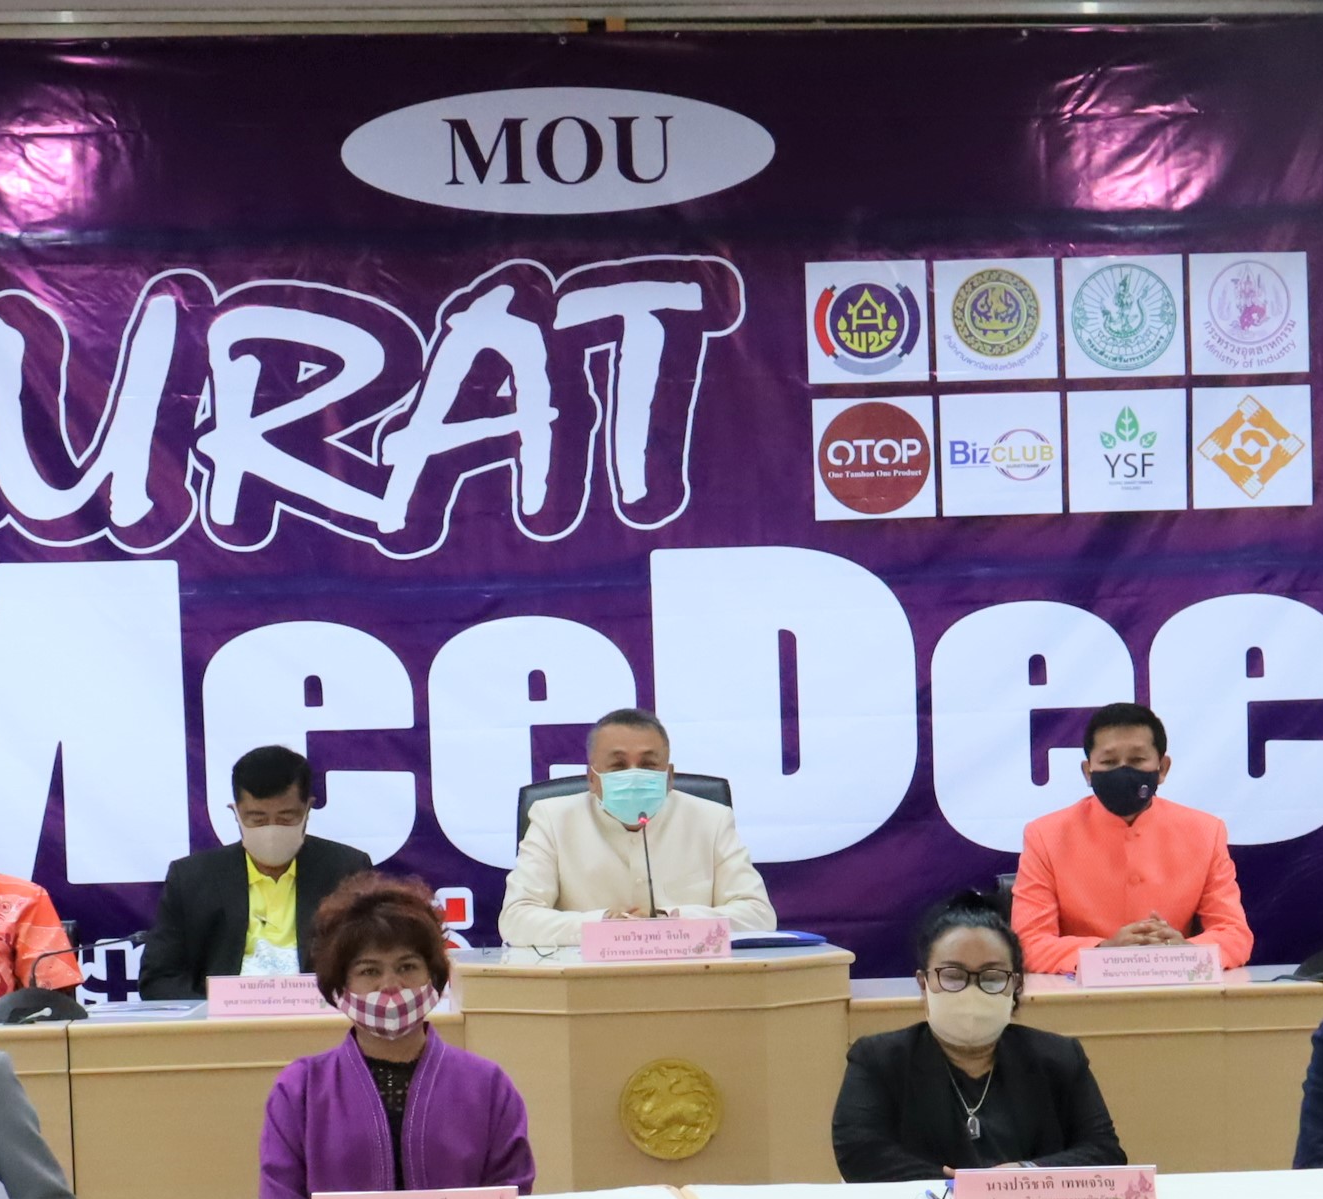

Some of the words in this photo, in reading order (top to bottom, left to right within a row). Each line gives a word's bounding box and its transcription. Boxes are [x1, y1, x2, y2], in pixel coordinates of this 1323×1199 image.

[441, 115, 675, 187] MOU
[1203, 339, 1239, 368] Ministry
[1242, 358, 1254, 368] of
[1256, 339, 1297, 368] Industry
[827, 438, 922, 466] OTOP
[828, 470, 843, 479] One
[876, 469, 892, 477] One
[893, 468, 922, 477] Product
[1104, 453, 1155, 479] YSF
[986, 1175, 1055, 1192] นางปาริชาติ
[1061, 1176, 1115, 1191] เทพเจริญ
